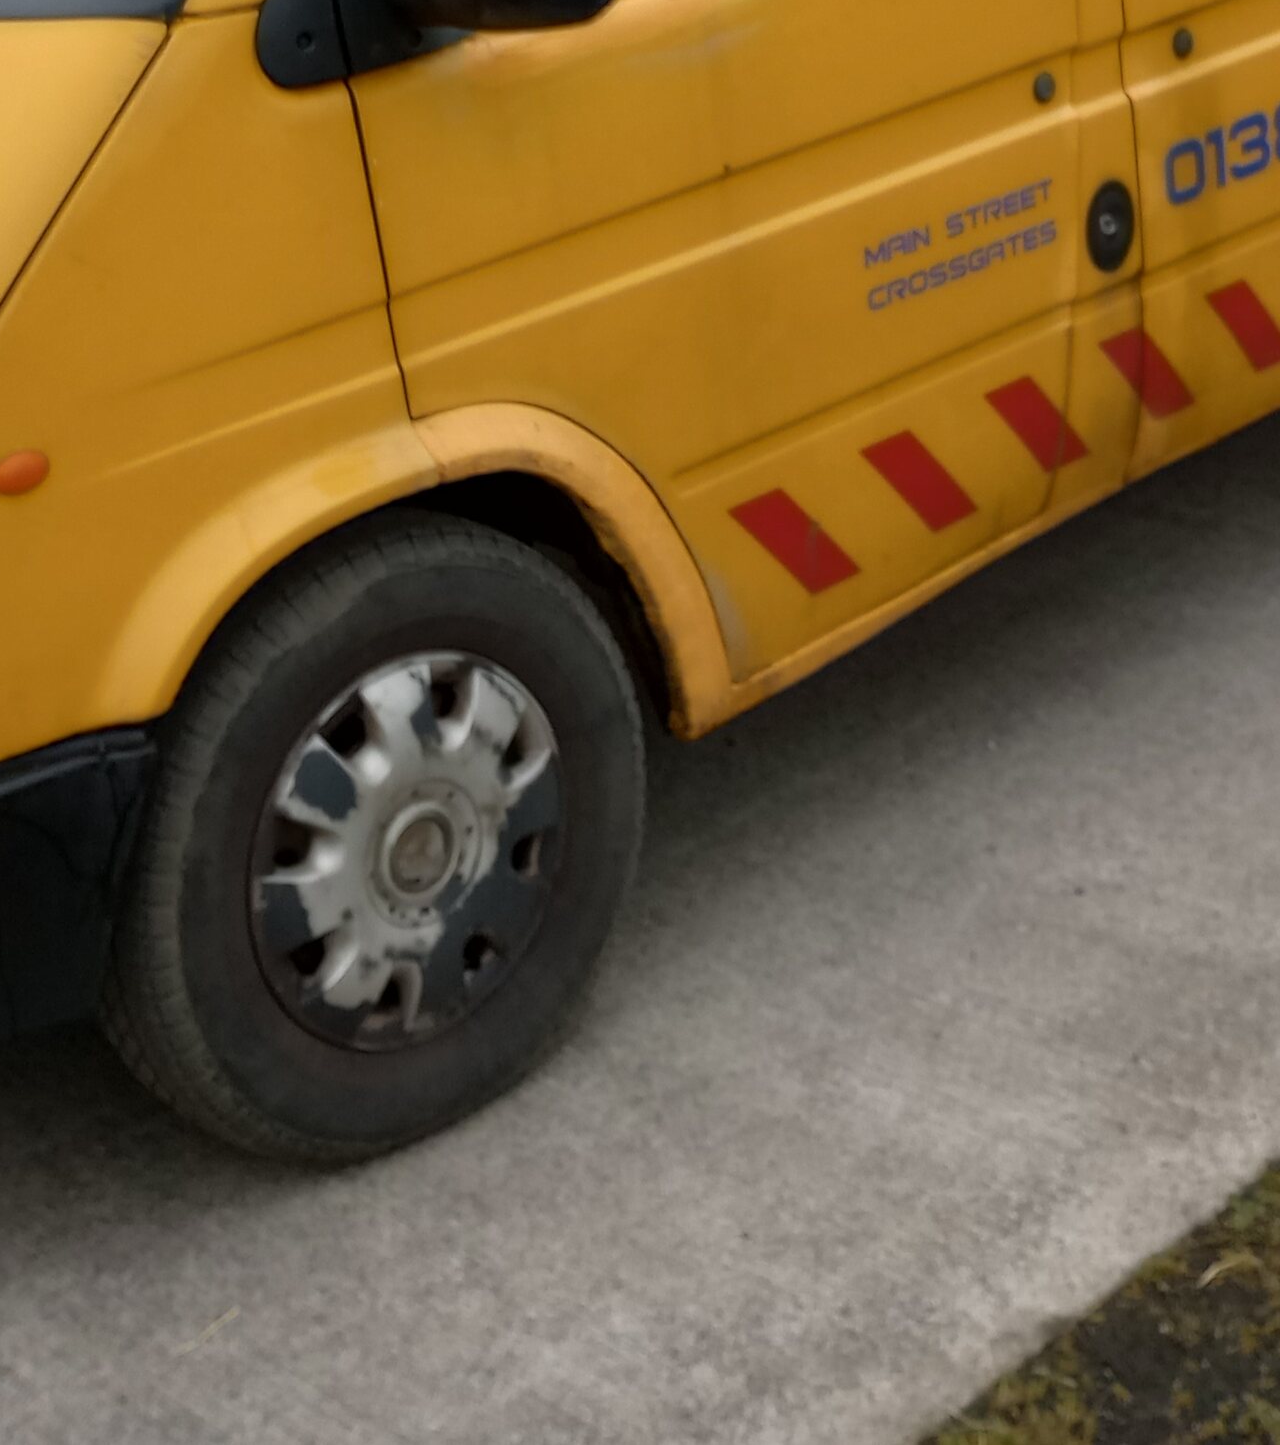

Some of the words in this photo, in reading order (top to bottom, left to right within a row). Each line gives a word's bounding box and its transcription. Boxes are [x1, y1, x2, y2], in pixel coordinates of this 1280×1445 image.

[864, 225, 931, 268] MAIN
[945, 178, 1053, 238] STREET
[867, 220, 1058, 312] CROSSGATES
